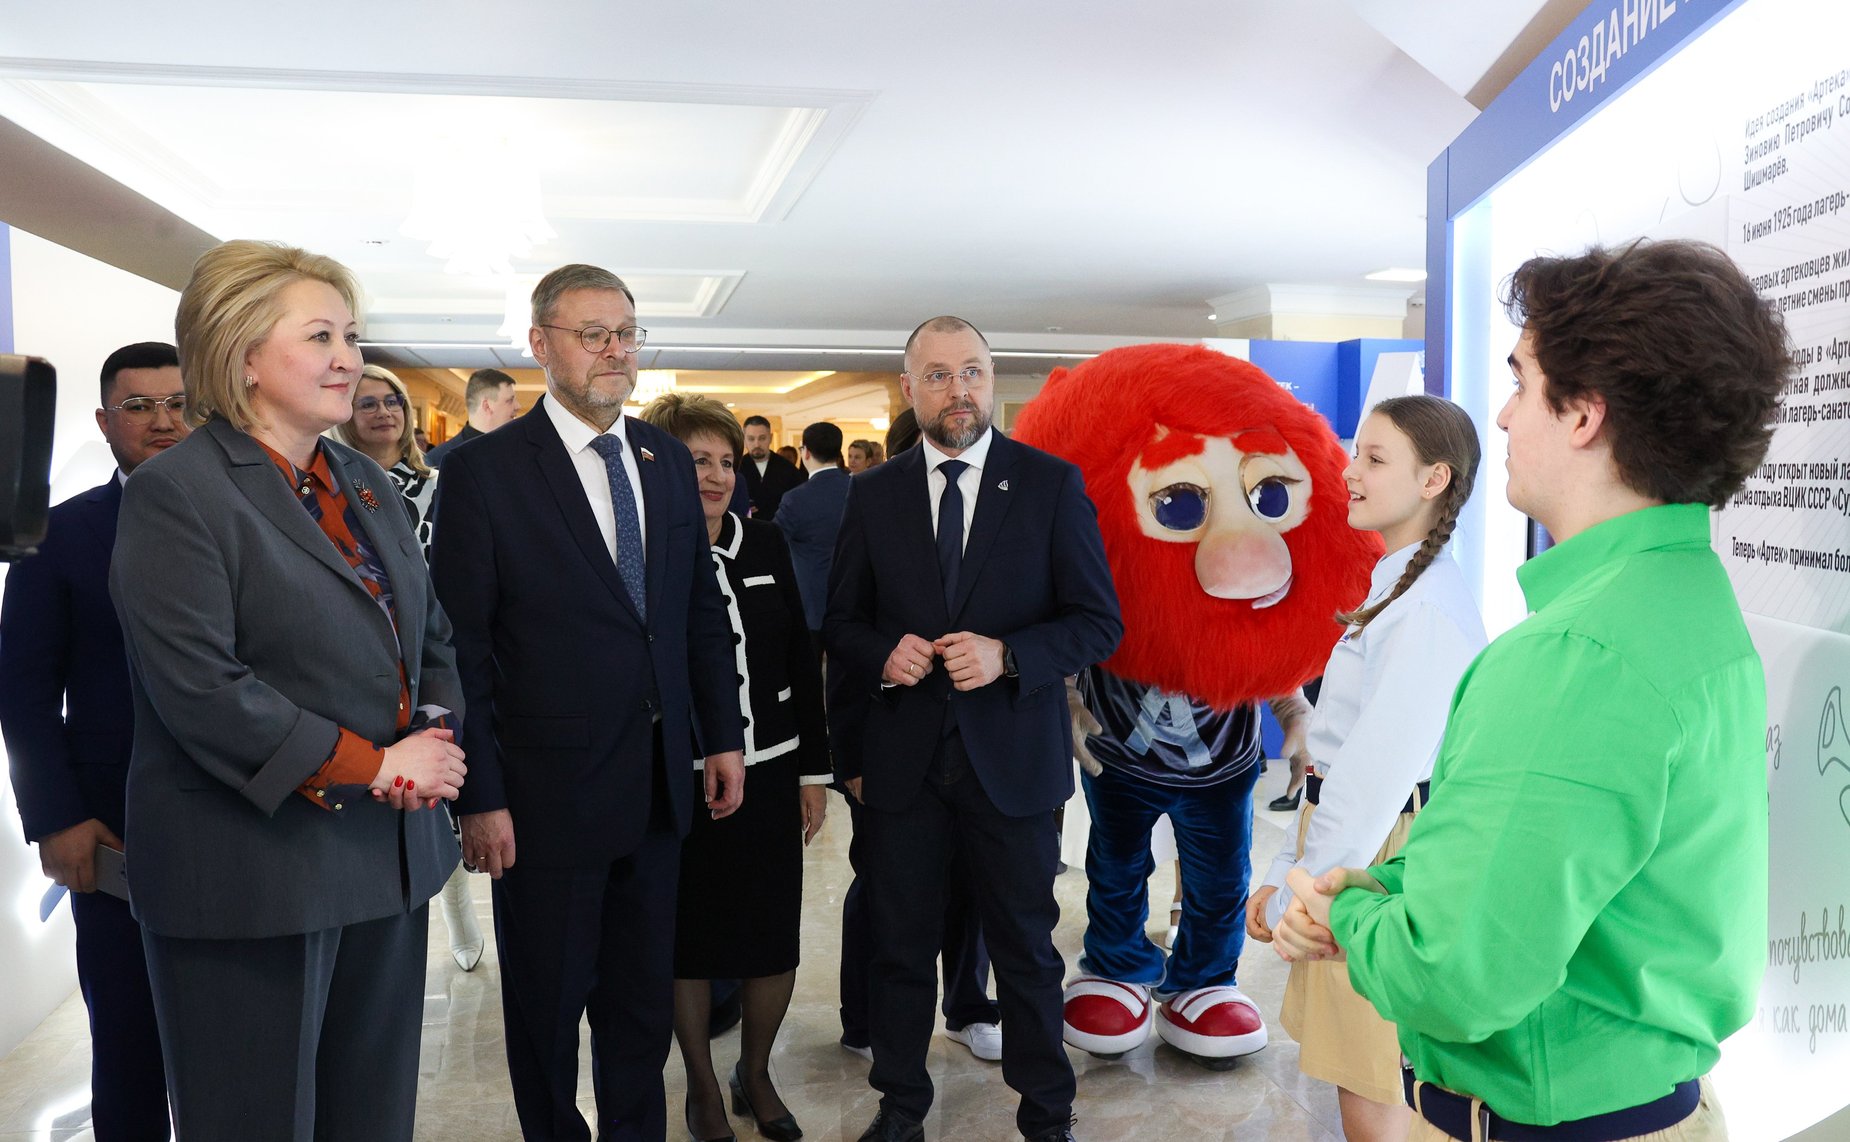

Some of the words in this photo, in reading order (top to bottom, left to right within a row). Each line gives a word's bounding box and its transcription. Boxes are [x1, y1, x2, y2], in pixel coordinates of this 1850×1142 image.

[1745, 117, 1764, 139] Идея
[1766, 92, 1804, 127] создания
[1744, 133, 1780, 165] Зиновию
[1785, 105, 1833, 145] Петровичу
[1744, 155, 1788, 191] Шишмарёв.
[1743, 222, 1751, 244] 16
[1751, 218, 1772, 240] июня
[1773, 205, 1792, 232] 1925
[1792, 202, 1812, 226] года
[1813, 190, 1850, 216] лагерь-
[1781, 255, 1830, 289] артековцев
[1807, 282, 1837, 306] смены
[1817, 345, 1823, 363] в
[1778, 463, 1808, 484] открыт
[1809, 458, 1838, 480] новый
[1753, 490, 1782, 510] отдыха
[1783, 486, 1807, 512] ВЦИК
[1808, 487, 1831, 510] СССР
[1732, 536, 1756, 563] Теперь
[1756, 540, 1789, 566] «Артек»
[1789, 547, 1833, 570] принимал
[1773, 1004, 1800, 1033] как
[1809, 1003, 1848, 1054] дома
